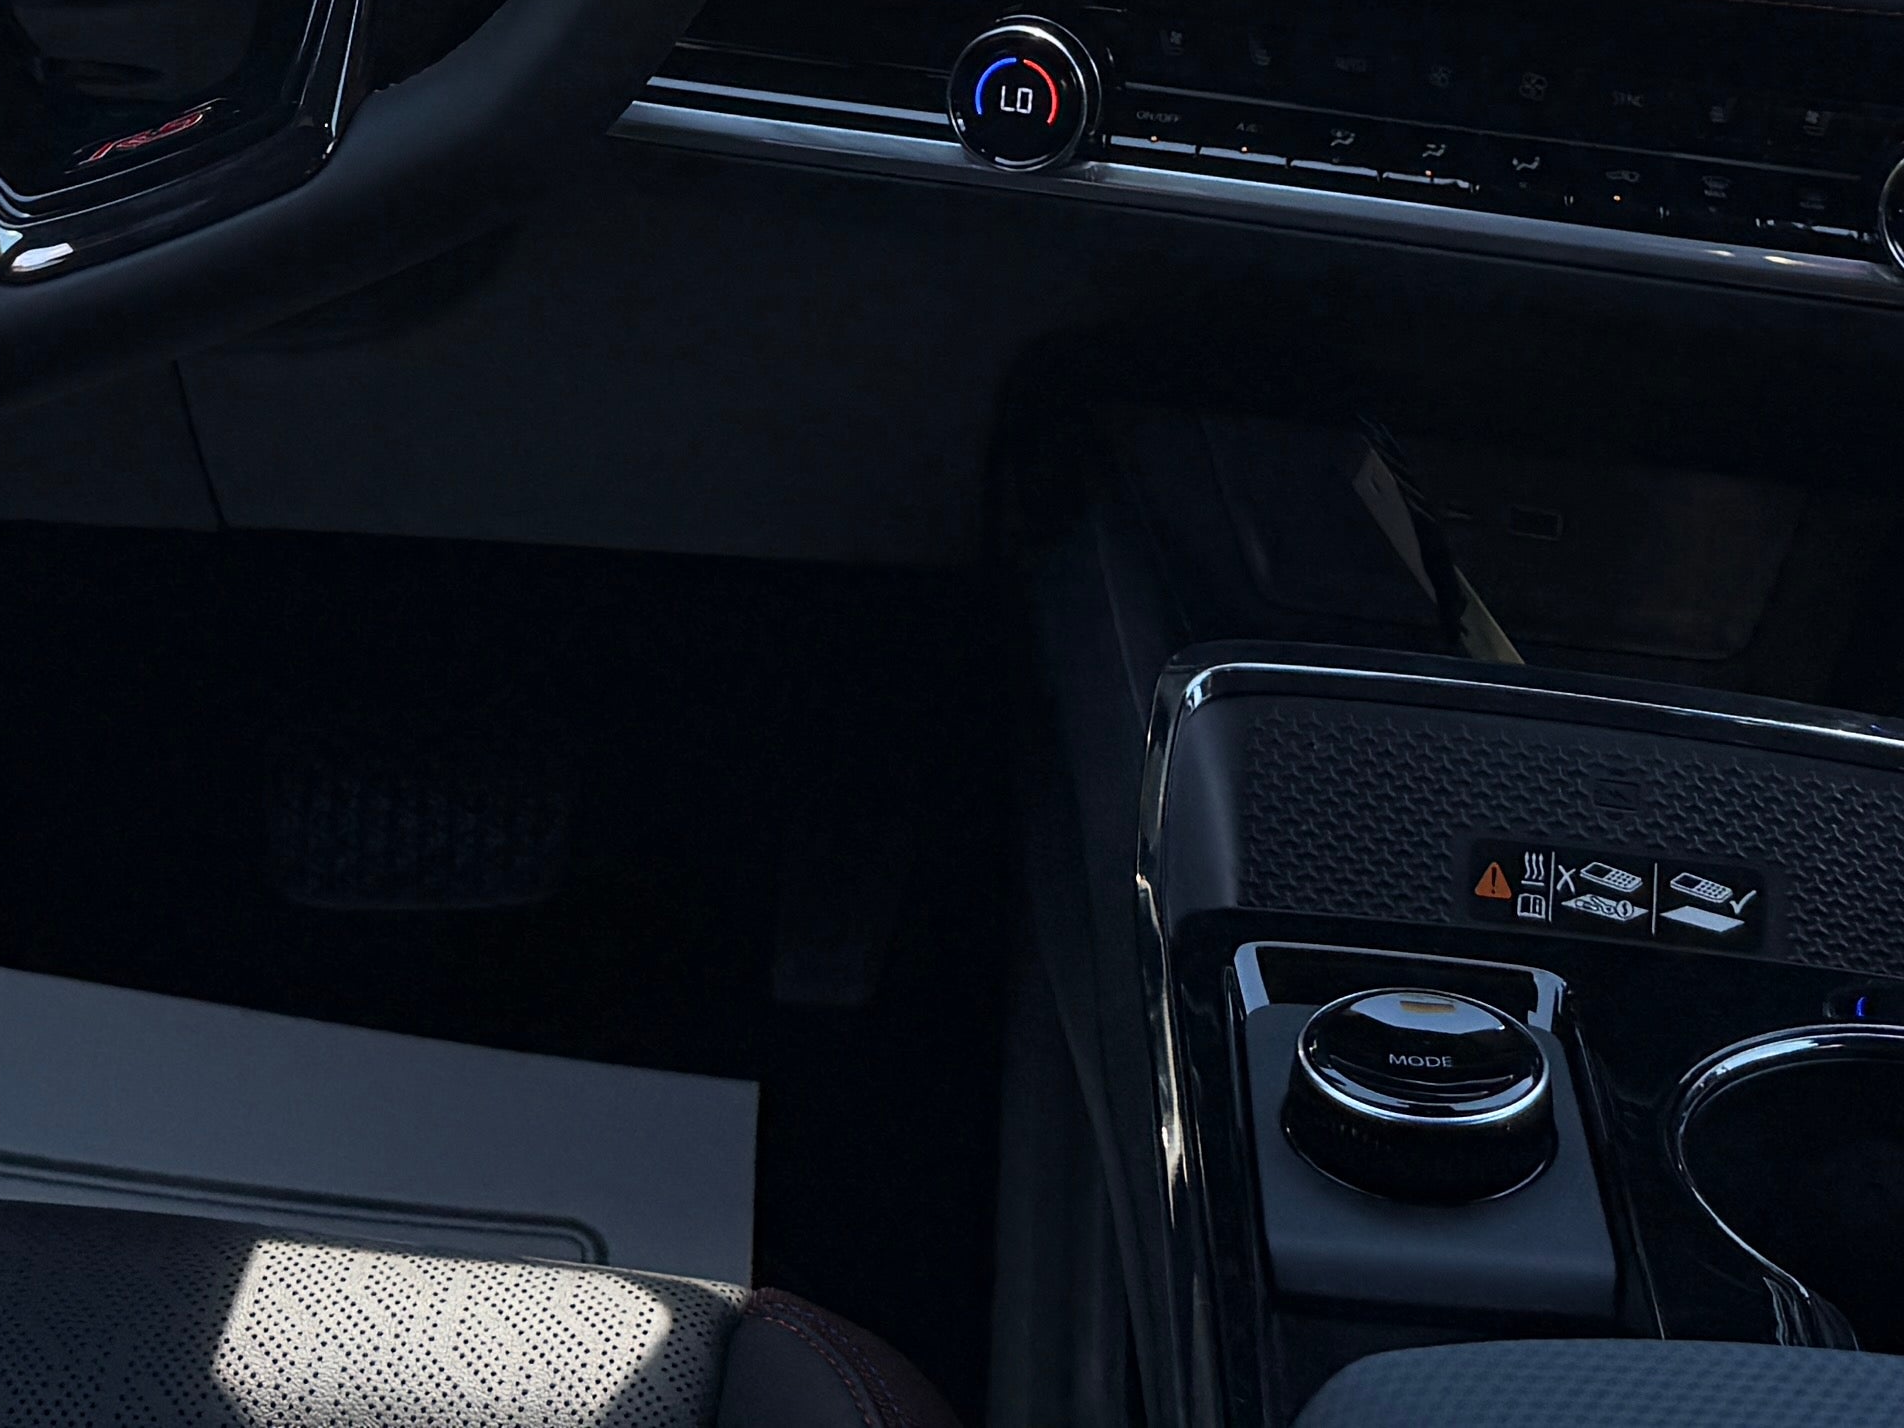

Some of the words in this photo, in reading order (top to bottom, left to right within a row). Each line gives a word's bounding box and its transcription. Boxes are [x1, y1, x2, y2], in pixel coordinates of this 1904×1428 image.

[1000, 85, 1034, 115] LO
[86, 112, 205, 163] RS
[1388, 1053, 1453, 1067] MODE
